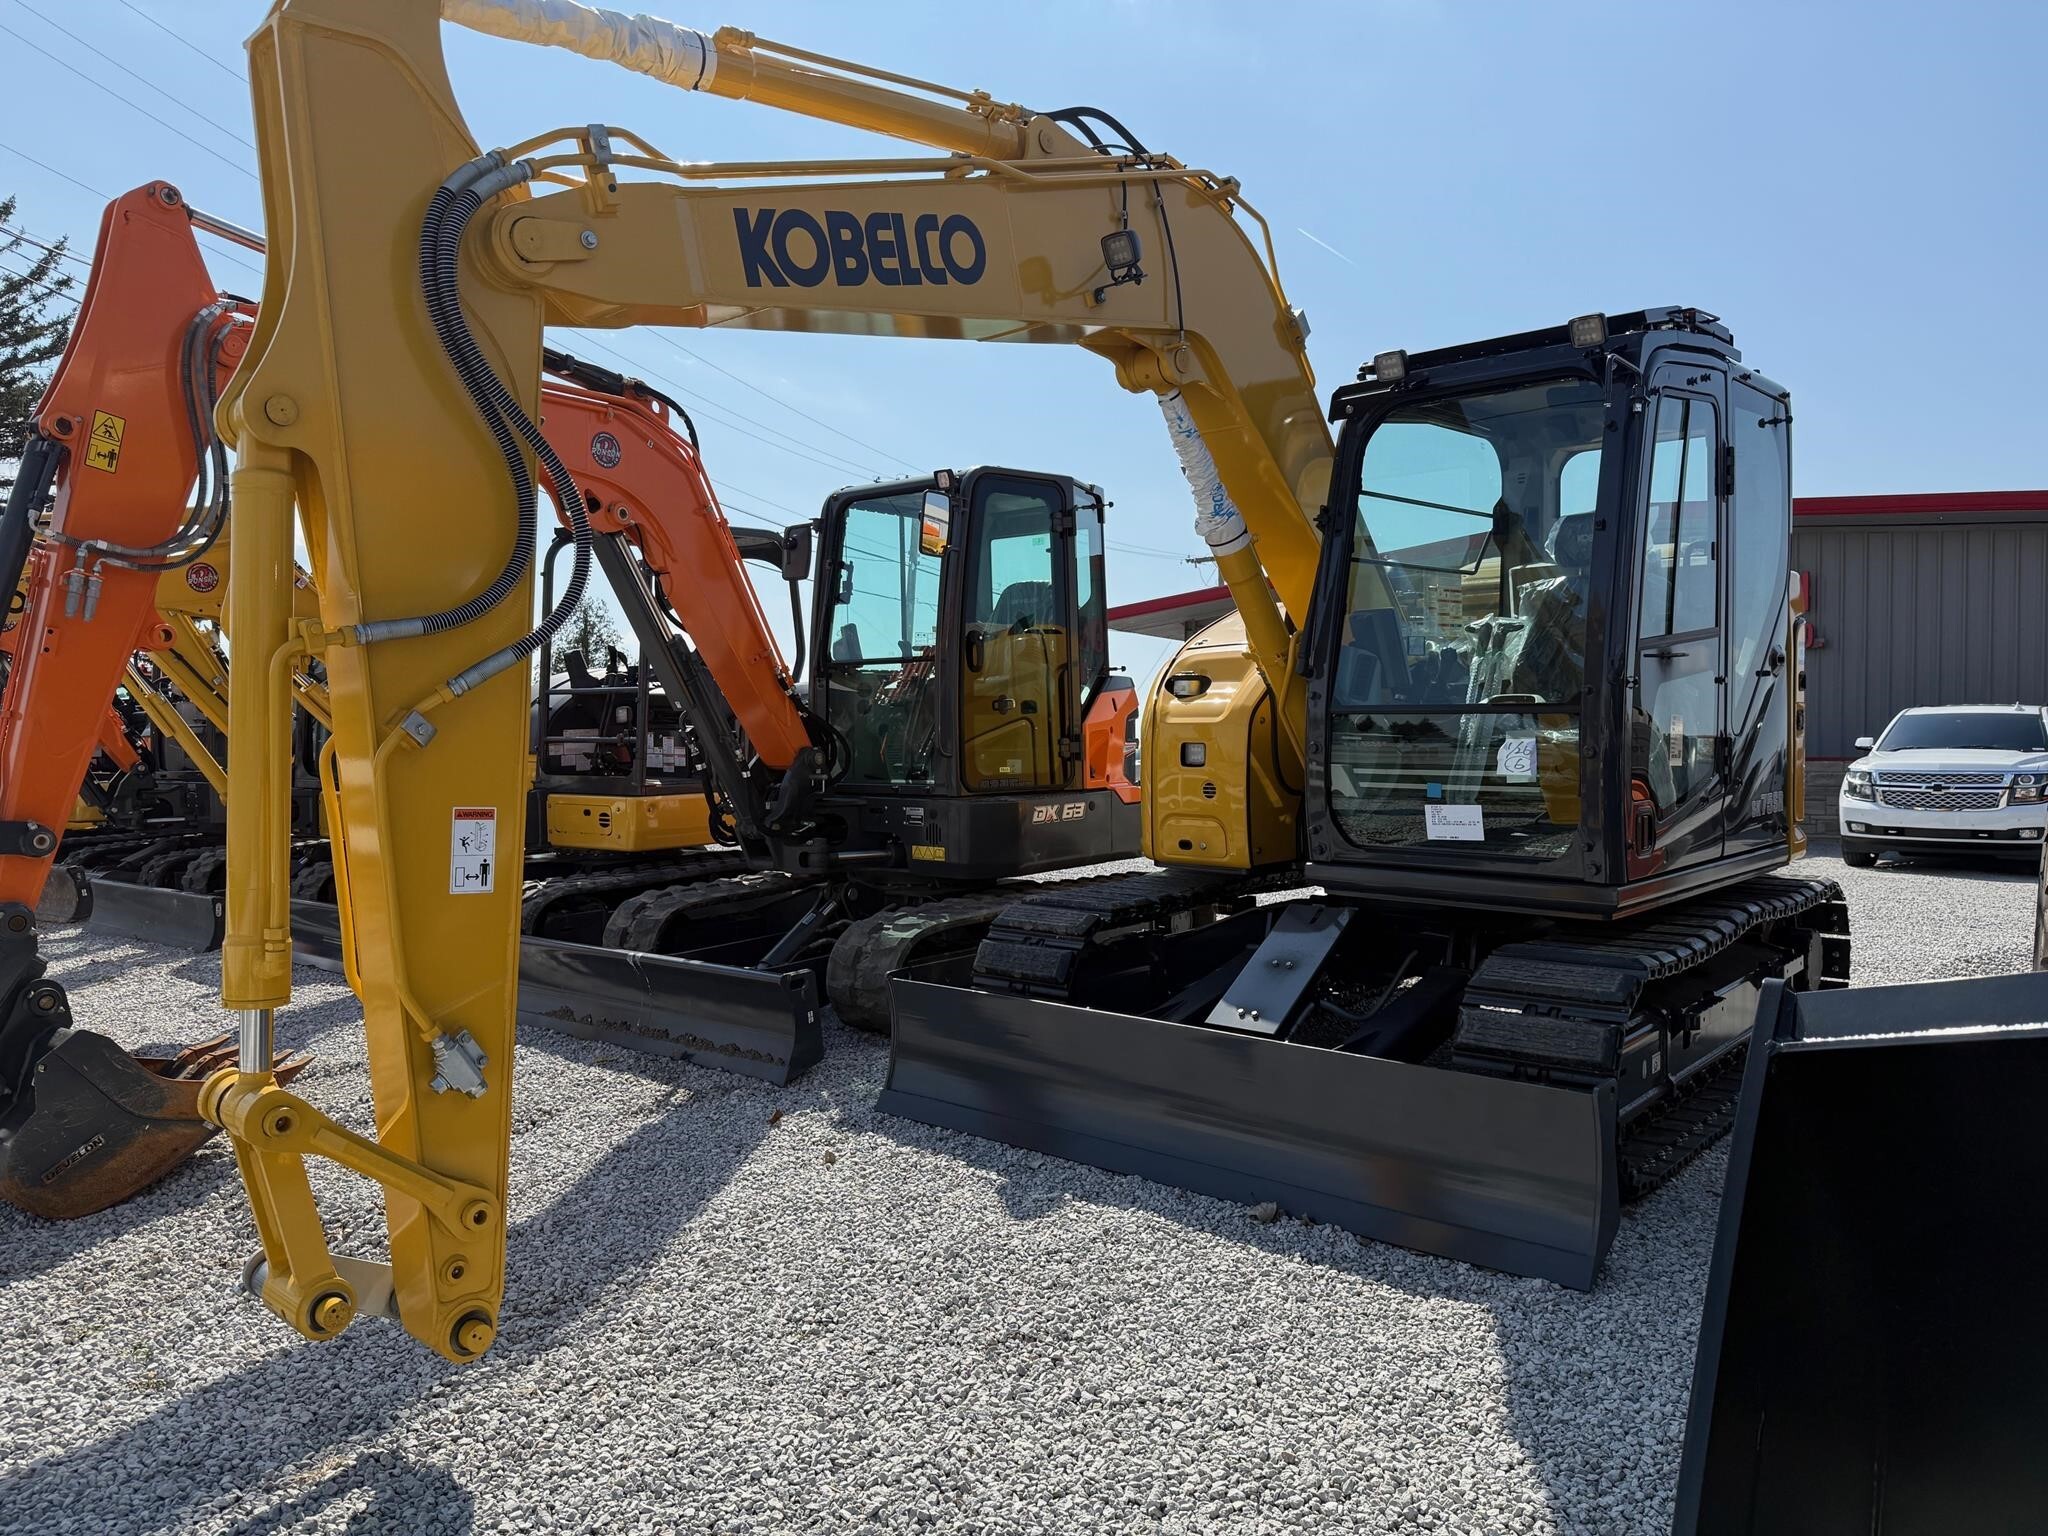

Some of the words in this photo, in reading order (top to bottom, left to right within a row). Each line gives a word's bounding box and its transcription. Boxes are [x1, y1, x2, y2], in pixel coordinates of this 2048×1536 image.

[733, 207, 987, 288] KOBELCO
[1032, 804, 1060, 824] DX
[1062, 801, 1086, 821] 63
[45, 1136, 103, 1181] DEVELON
